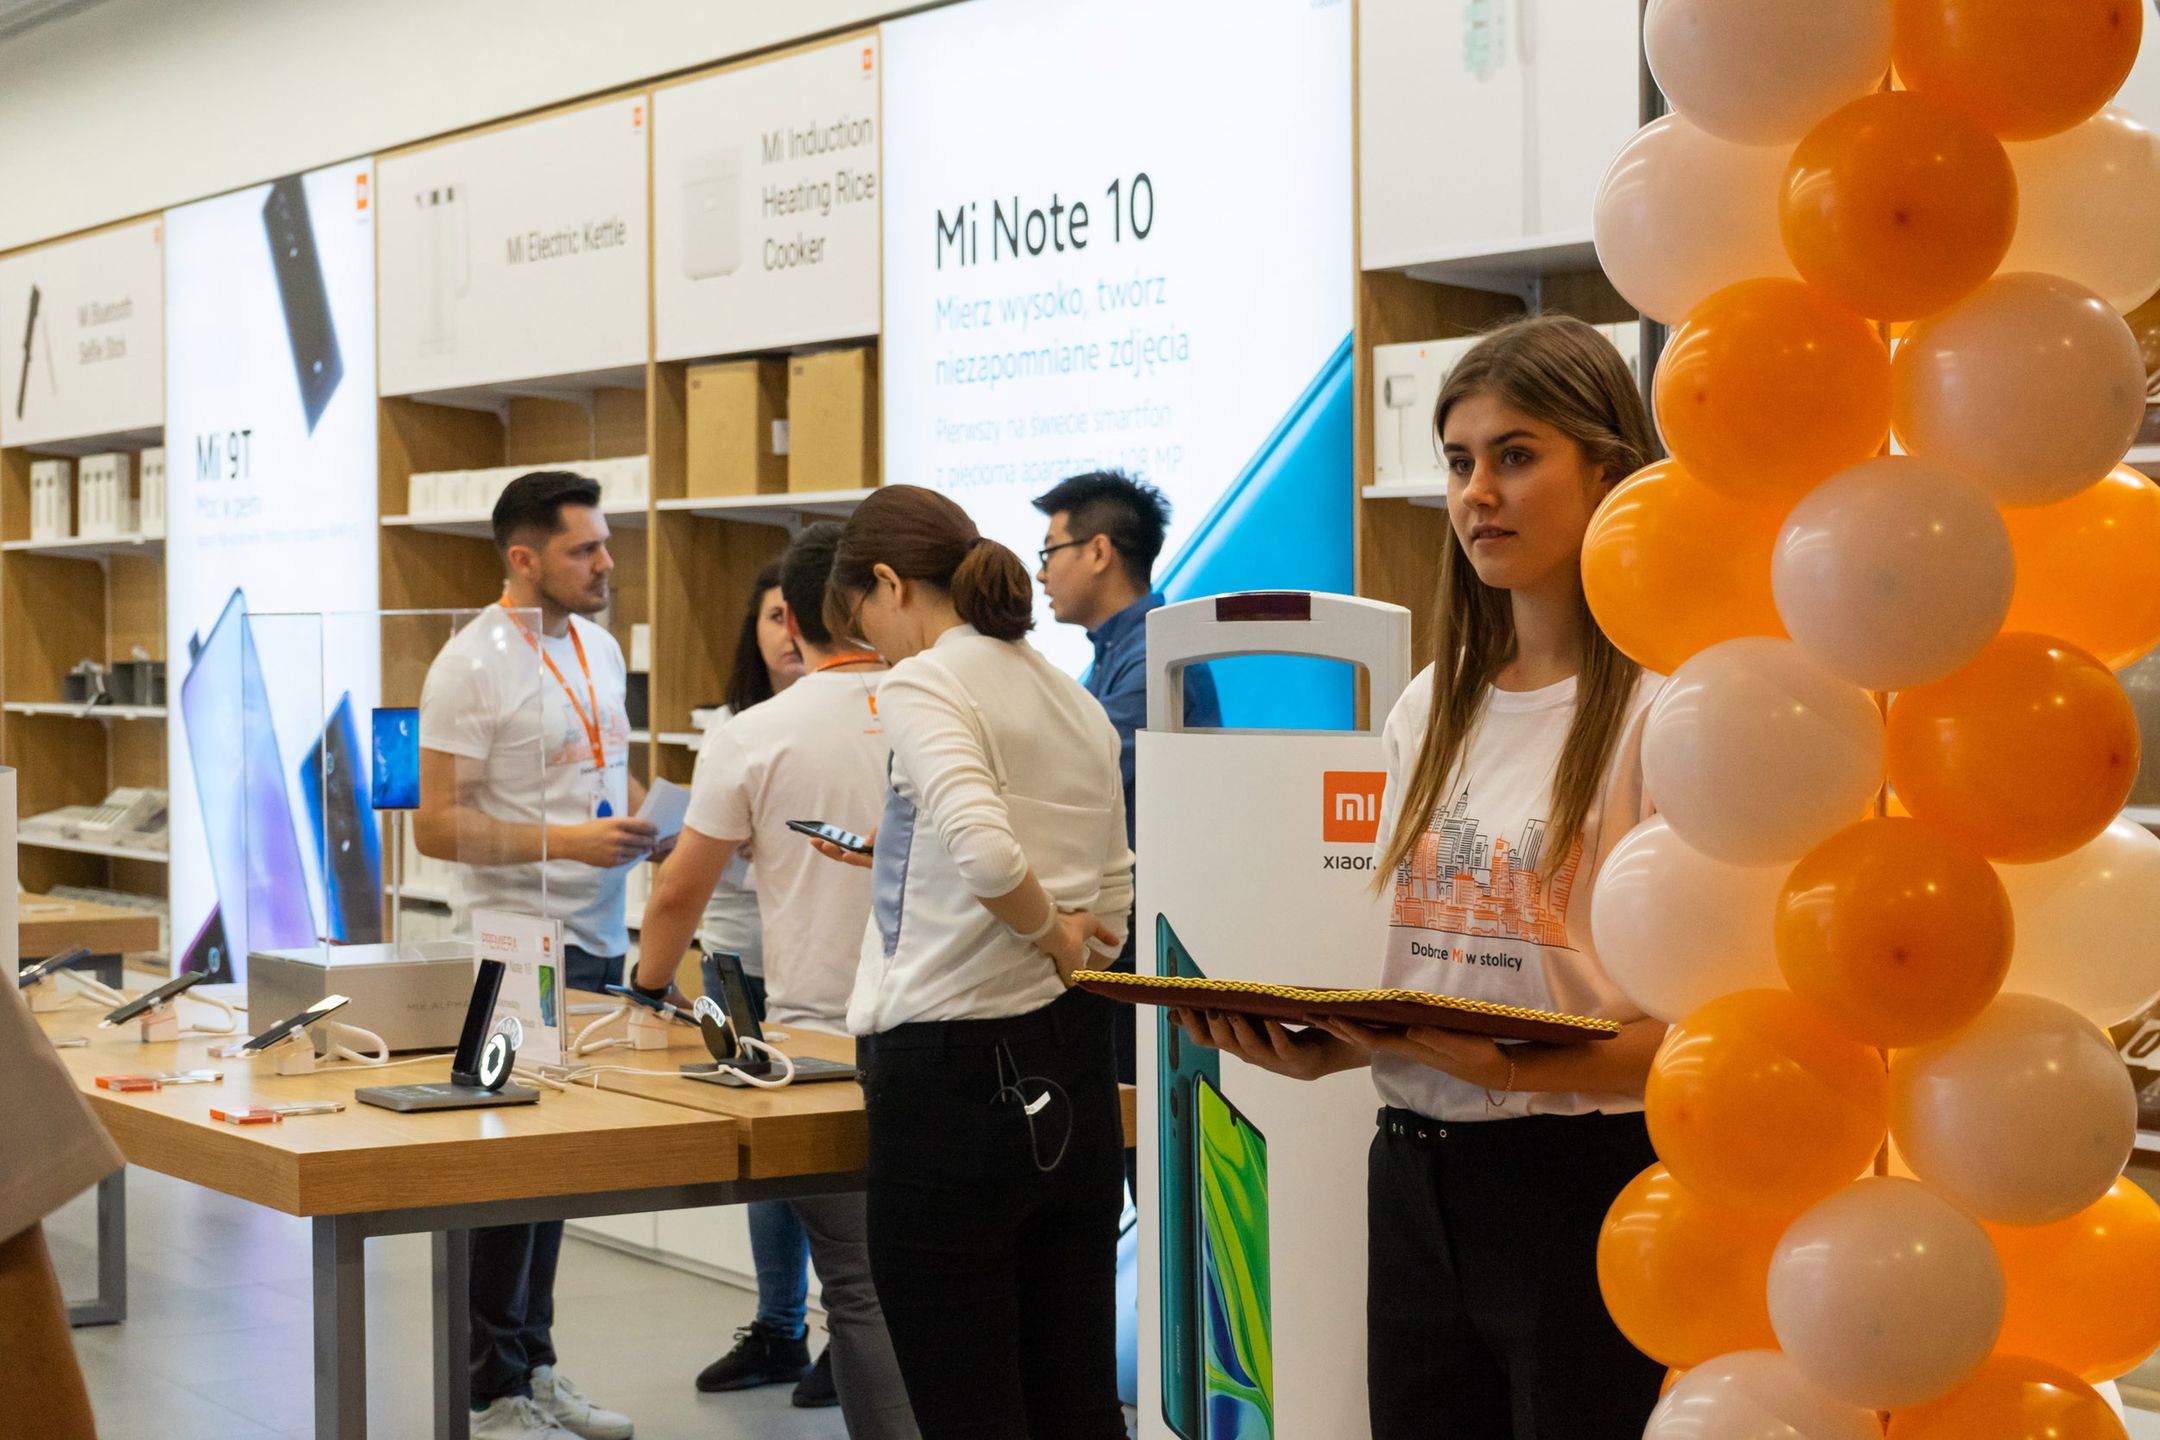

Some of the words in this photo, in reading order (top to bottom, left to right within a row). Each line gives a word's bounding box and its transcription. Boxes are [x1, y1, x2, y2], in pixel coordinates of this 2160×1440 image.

[761, 128, 784, 166] Mi
[788, 116, 873, 158] Induction
[761, 177, 831, 218] Heating
[835, 167, 875, 206] Rice
[506, 233, 525, 265] Mi
[527, 224, 580, 262] Electric
[582, 215, 627, 251] Kettle
[937, 202, 977, 270] Mi
[993, 193, 1089, 262] Note
[1106, 172, 1154, 243] 10
[763, 231, 825, 271] Cooker
[935, 294, 992, 332] Mierz
[1001, 279, 1088, 332] wysoko,
[1098, 267, 1166, 313] twórz
[935, 338, 1101, 391] niezapomniane
[1109, 322, 1189, 378] zdjęcia
[1093, 397, 1174, 434] smartfon
[196, 434, 221, 481] Mi
[227, 429, 253, 479] 9T
[1411, 941, 1448, 960] Dobrze
[1452, 948, 1464, 964] Mi
[1466, 952, 1476, 965] w
[1480, 953, 1523, 972] stolicy
